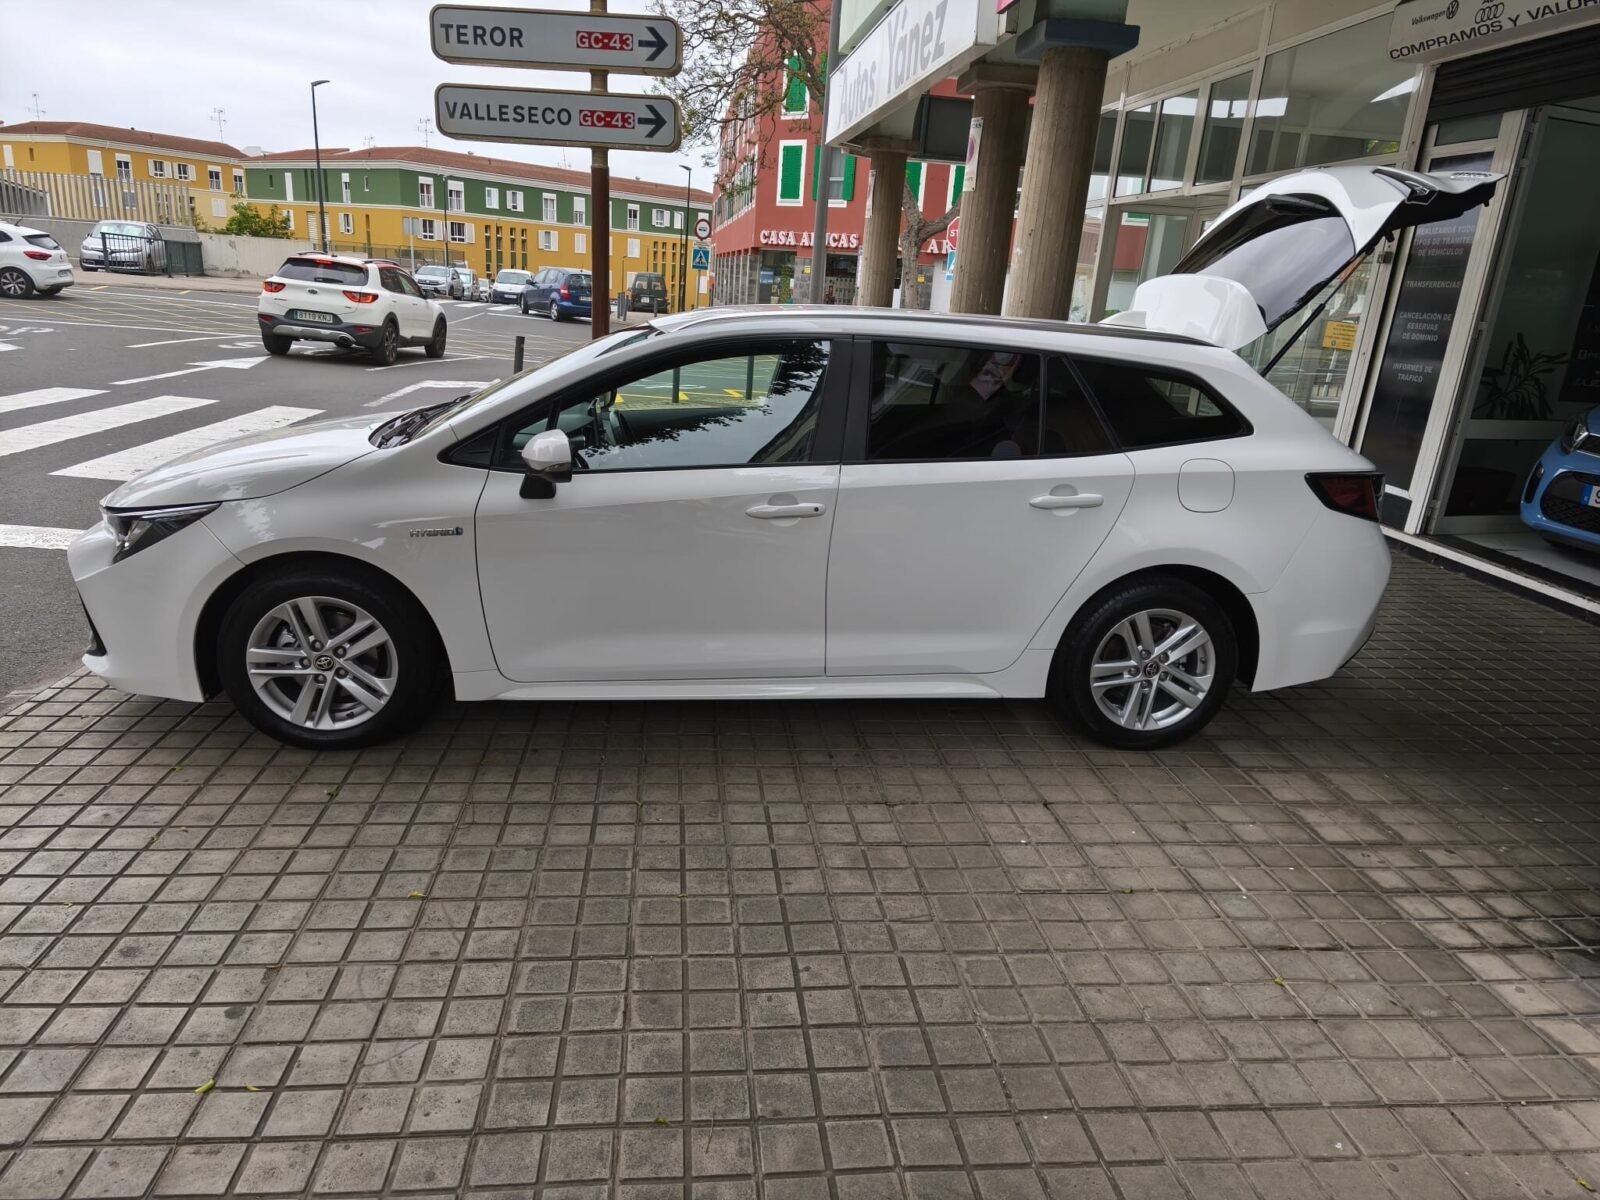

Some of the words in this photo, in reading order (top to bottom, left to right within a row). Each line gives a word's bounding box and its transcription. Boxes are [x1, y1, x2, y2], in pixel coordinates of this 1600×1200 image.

[440, 24, 524, 48] TEROR
[576, 31, 633, 50] GC-43
[1390, 19, 1503, 59] COMPRAMOS
[1507, 14, 1521, 28] Y
[445, 101, 572, 126] VALLESECO
[579, 109, 635, 129] GC-43
[760, 229, 796, 246] CASA
[800, 231, 859, 249] ACAS
